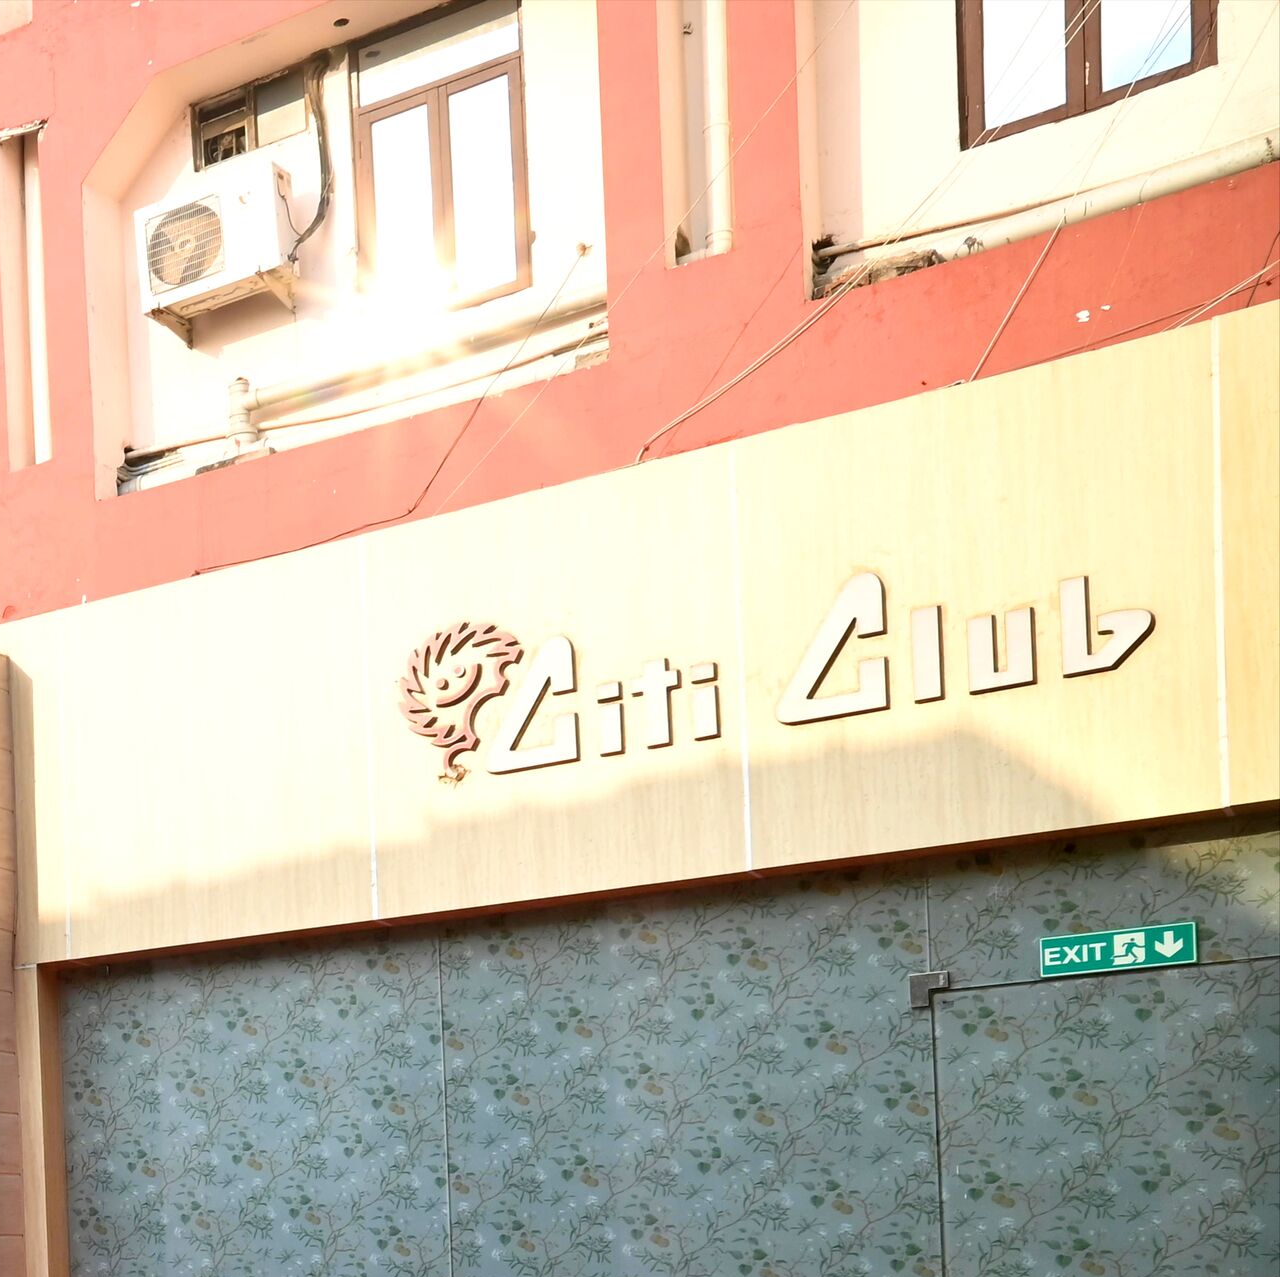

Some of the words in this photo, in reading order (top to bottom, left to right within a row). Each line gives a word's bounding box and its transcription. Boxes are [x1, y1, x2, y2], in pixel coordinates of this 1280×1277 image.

[486, 634, 722, 775] Citi
[774, 572, 1156, 726] Club
[1044, 942, 1107, 966] EXIT
